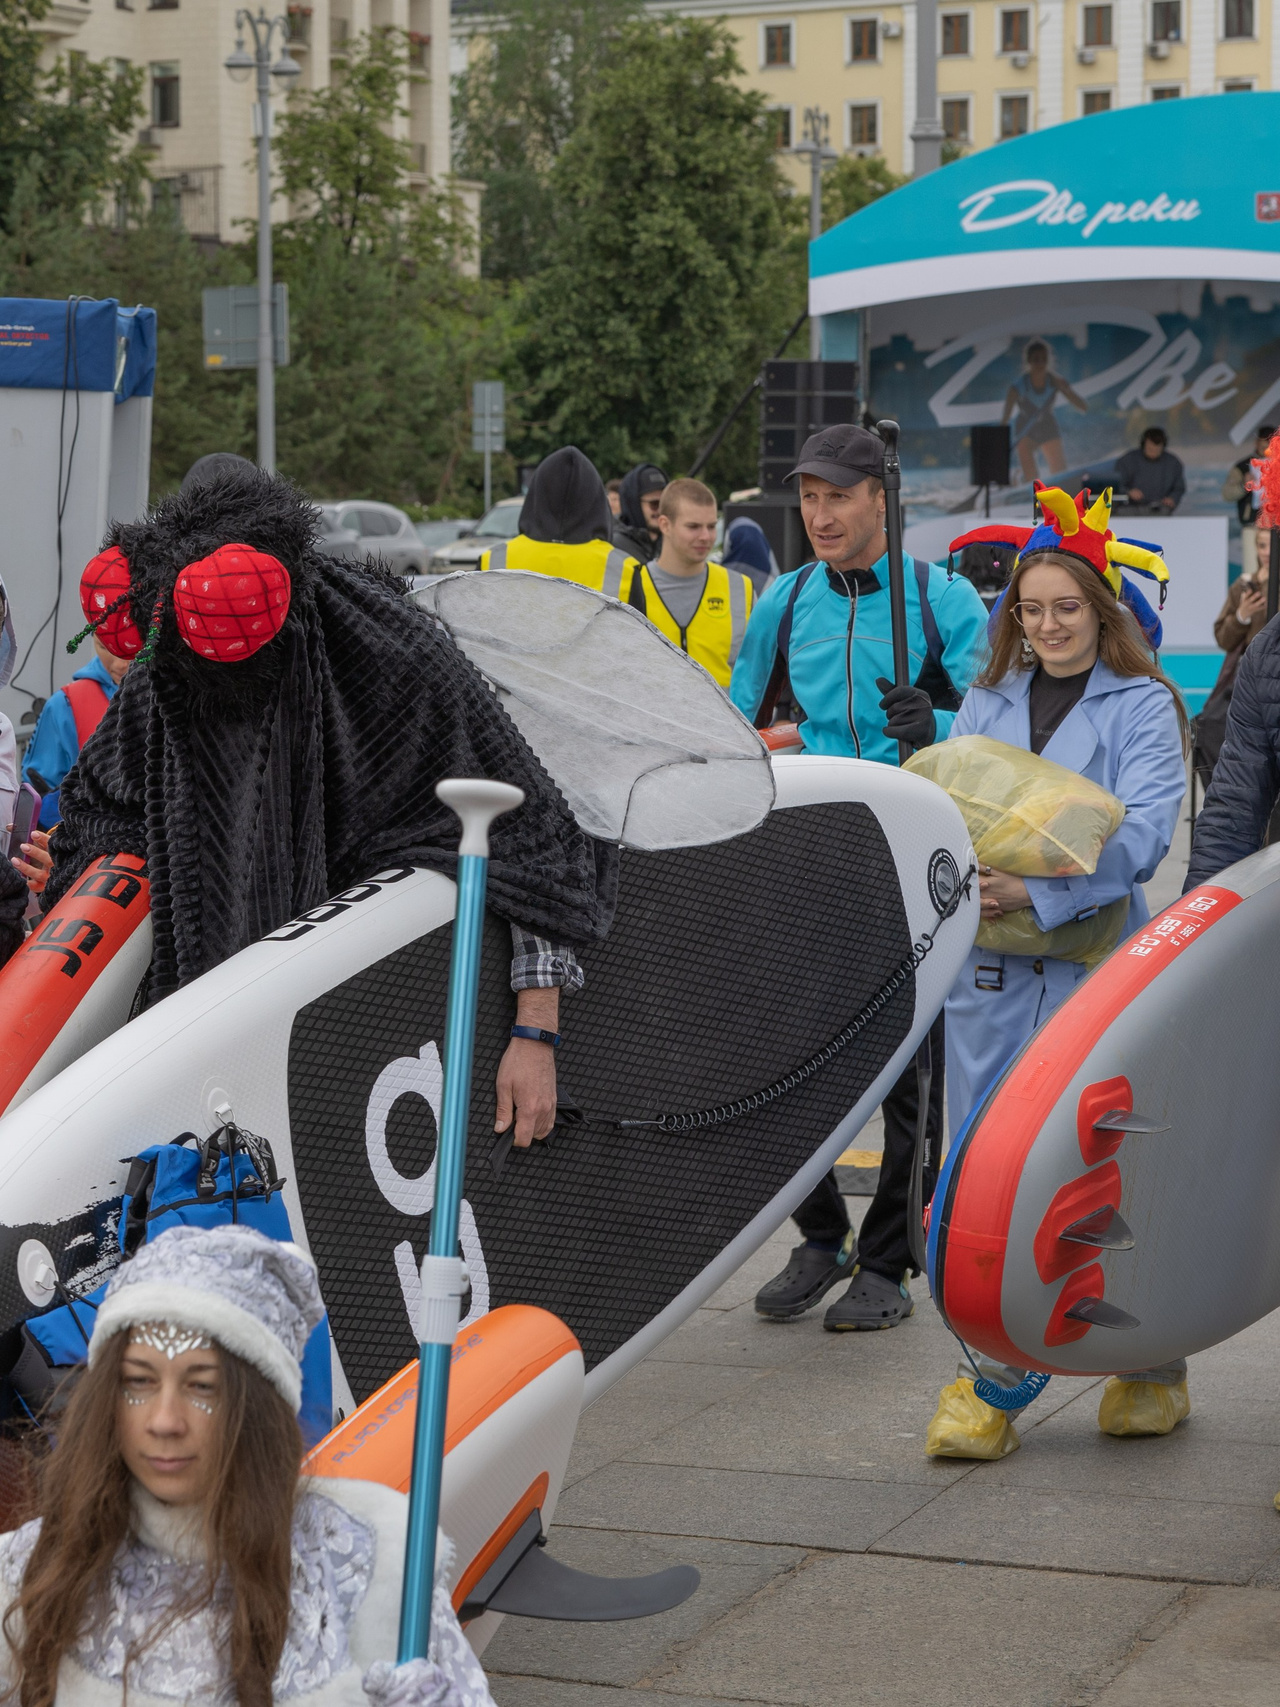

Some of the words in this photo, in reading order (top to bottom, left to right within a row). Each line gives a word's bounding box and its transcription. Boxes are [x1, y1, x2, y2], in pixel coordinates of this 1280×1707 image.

[958, 179, 1087, 234] Две
[1081, 192, 1202, 239] реки
[11, 332, 50, 340] DETECTOR
[27, 918, 104, 978] JS
